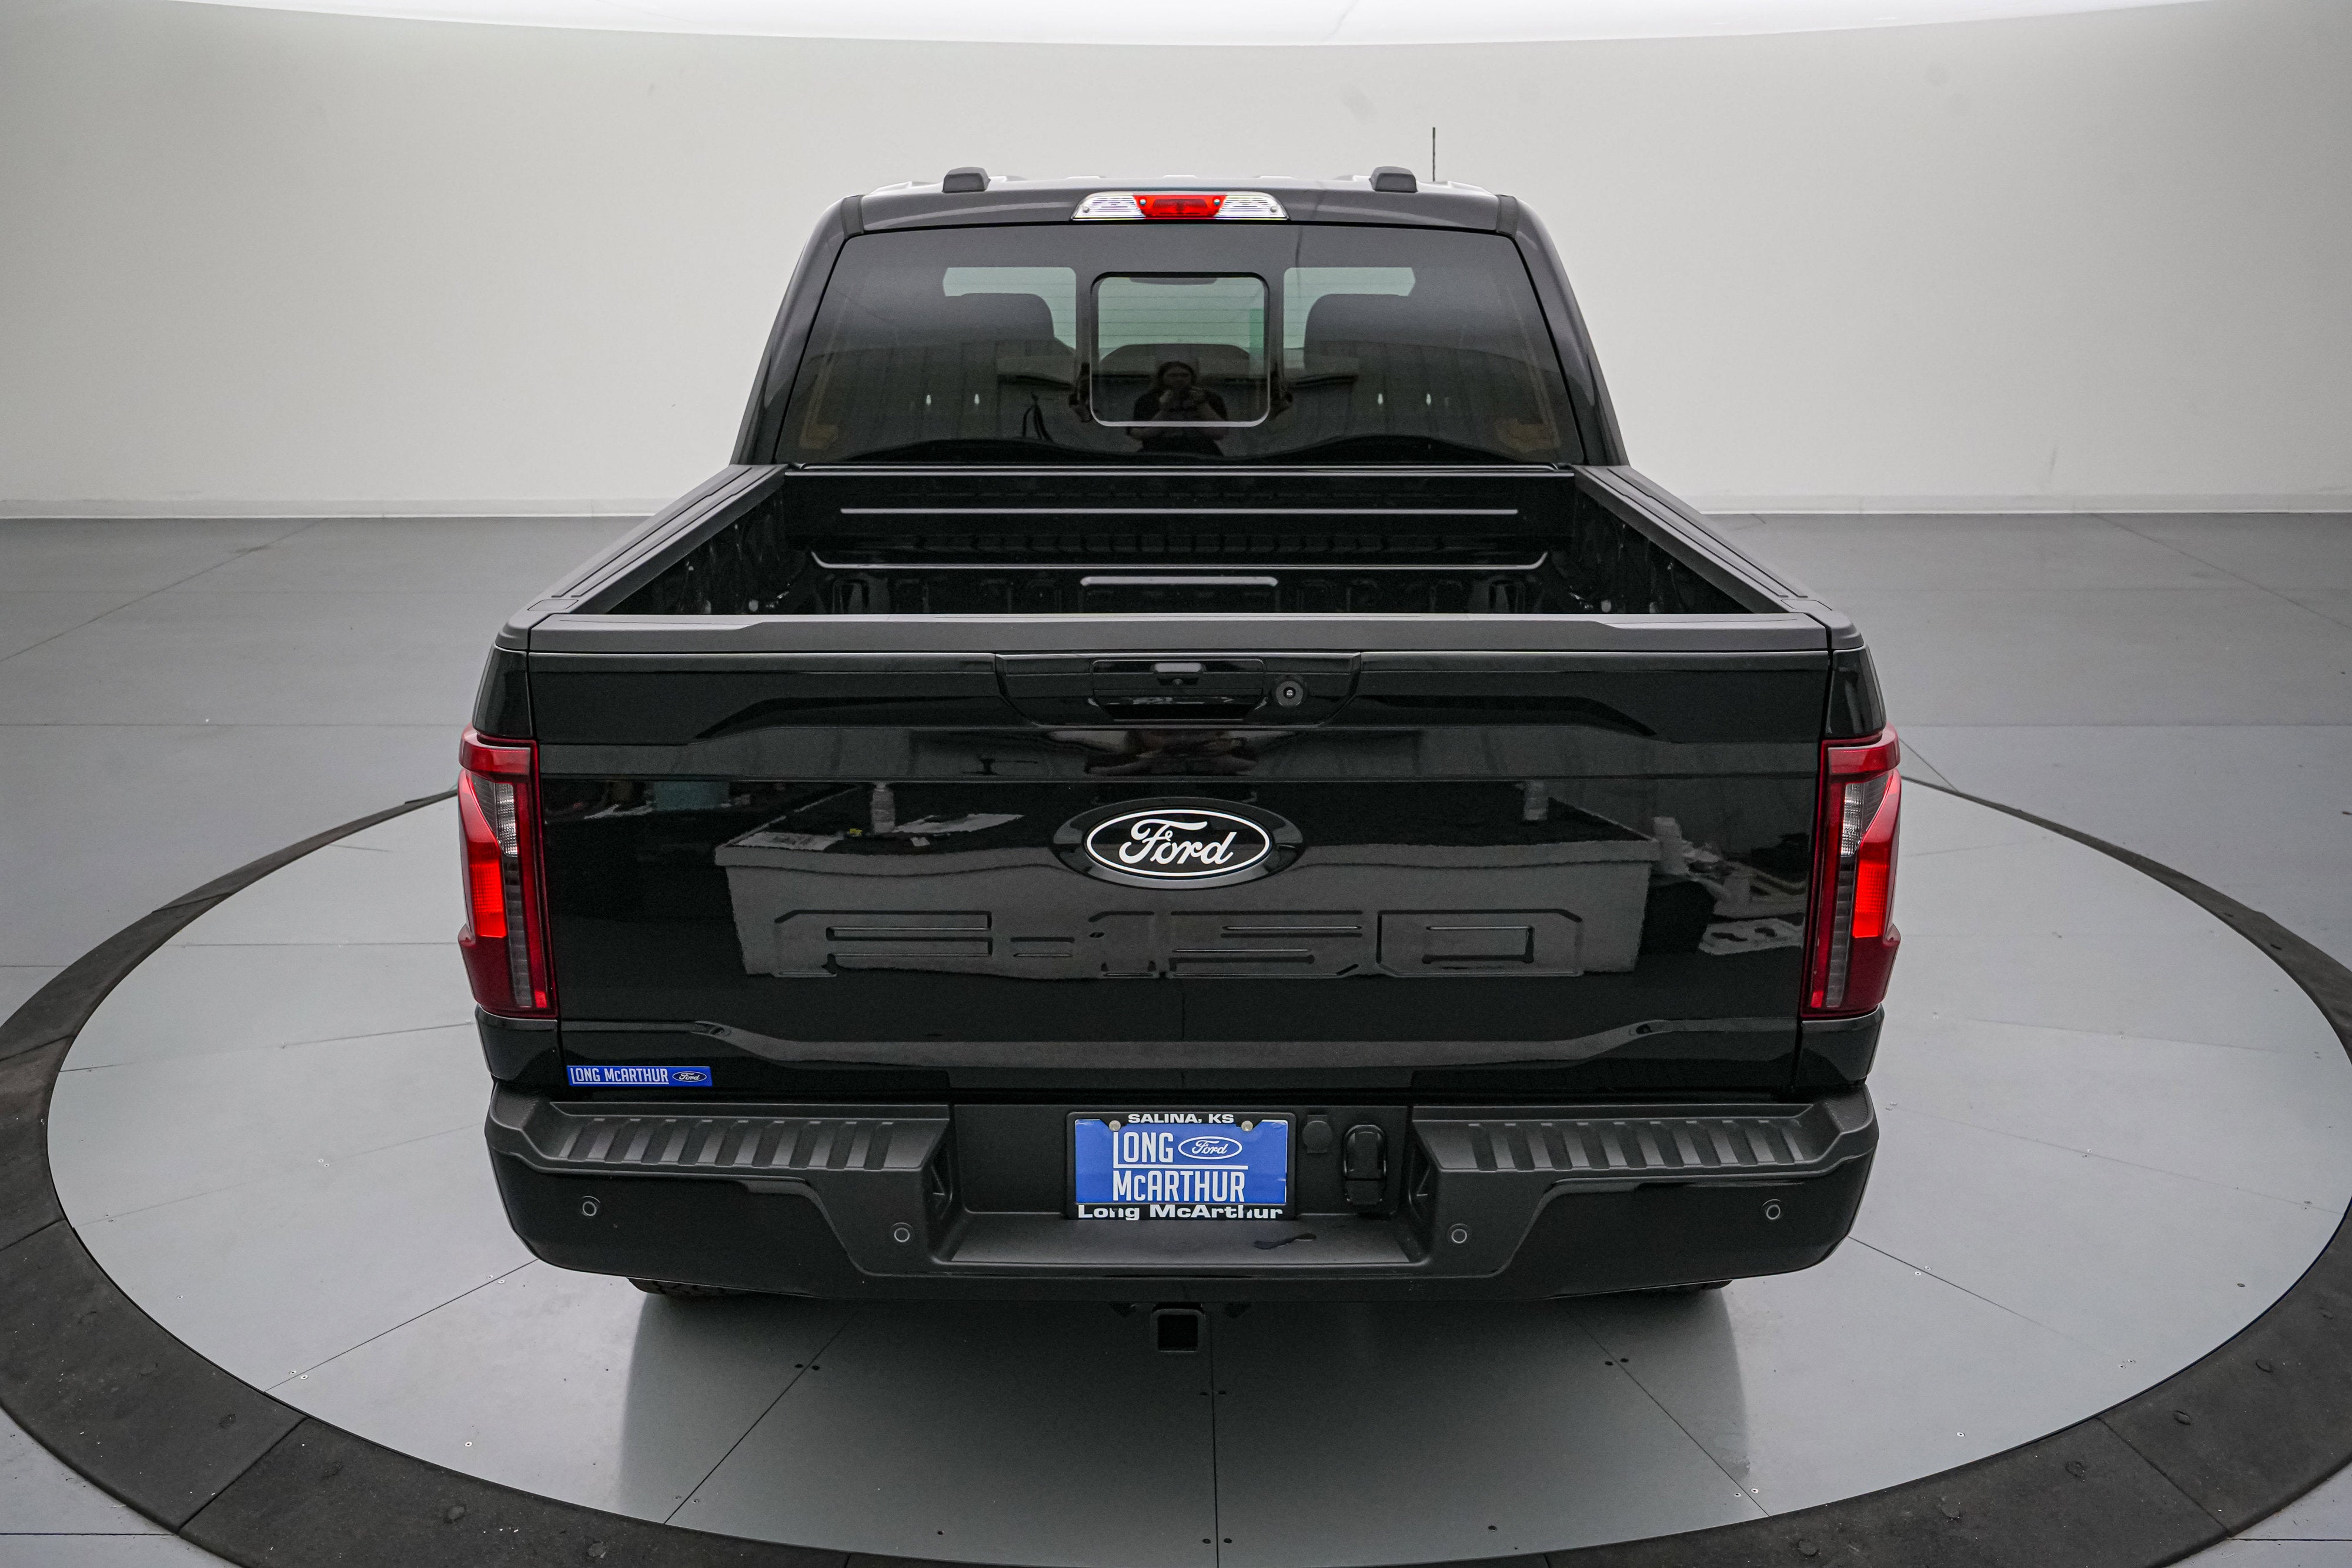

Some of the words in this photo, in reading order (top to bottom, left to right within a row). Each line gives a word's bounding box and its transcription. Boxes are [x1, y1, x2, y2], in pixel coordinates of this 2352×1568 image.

[1118, 819, 1237, 865] Ford
[570, 1068, 601, 1084] LONG
[604, 1068, 669, 1082] McARTHUR
[1127, 1114, 1202, 1124] SALINA,
[1209, 1114, 1234, 1124] KS
[1113, 1132, 1174, 1168] LONG
[1191, 1140, 1228, 1154] Ford
[1112, 1171, 1245, 1202] McARTHUR
[1078, 1205, 1140, 1221] Long
[1149, 1205, 1283, 1219] McArthur
